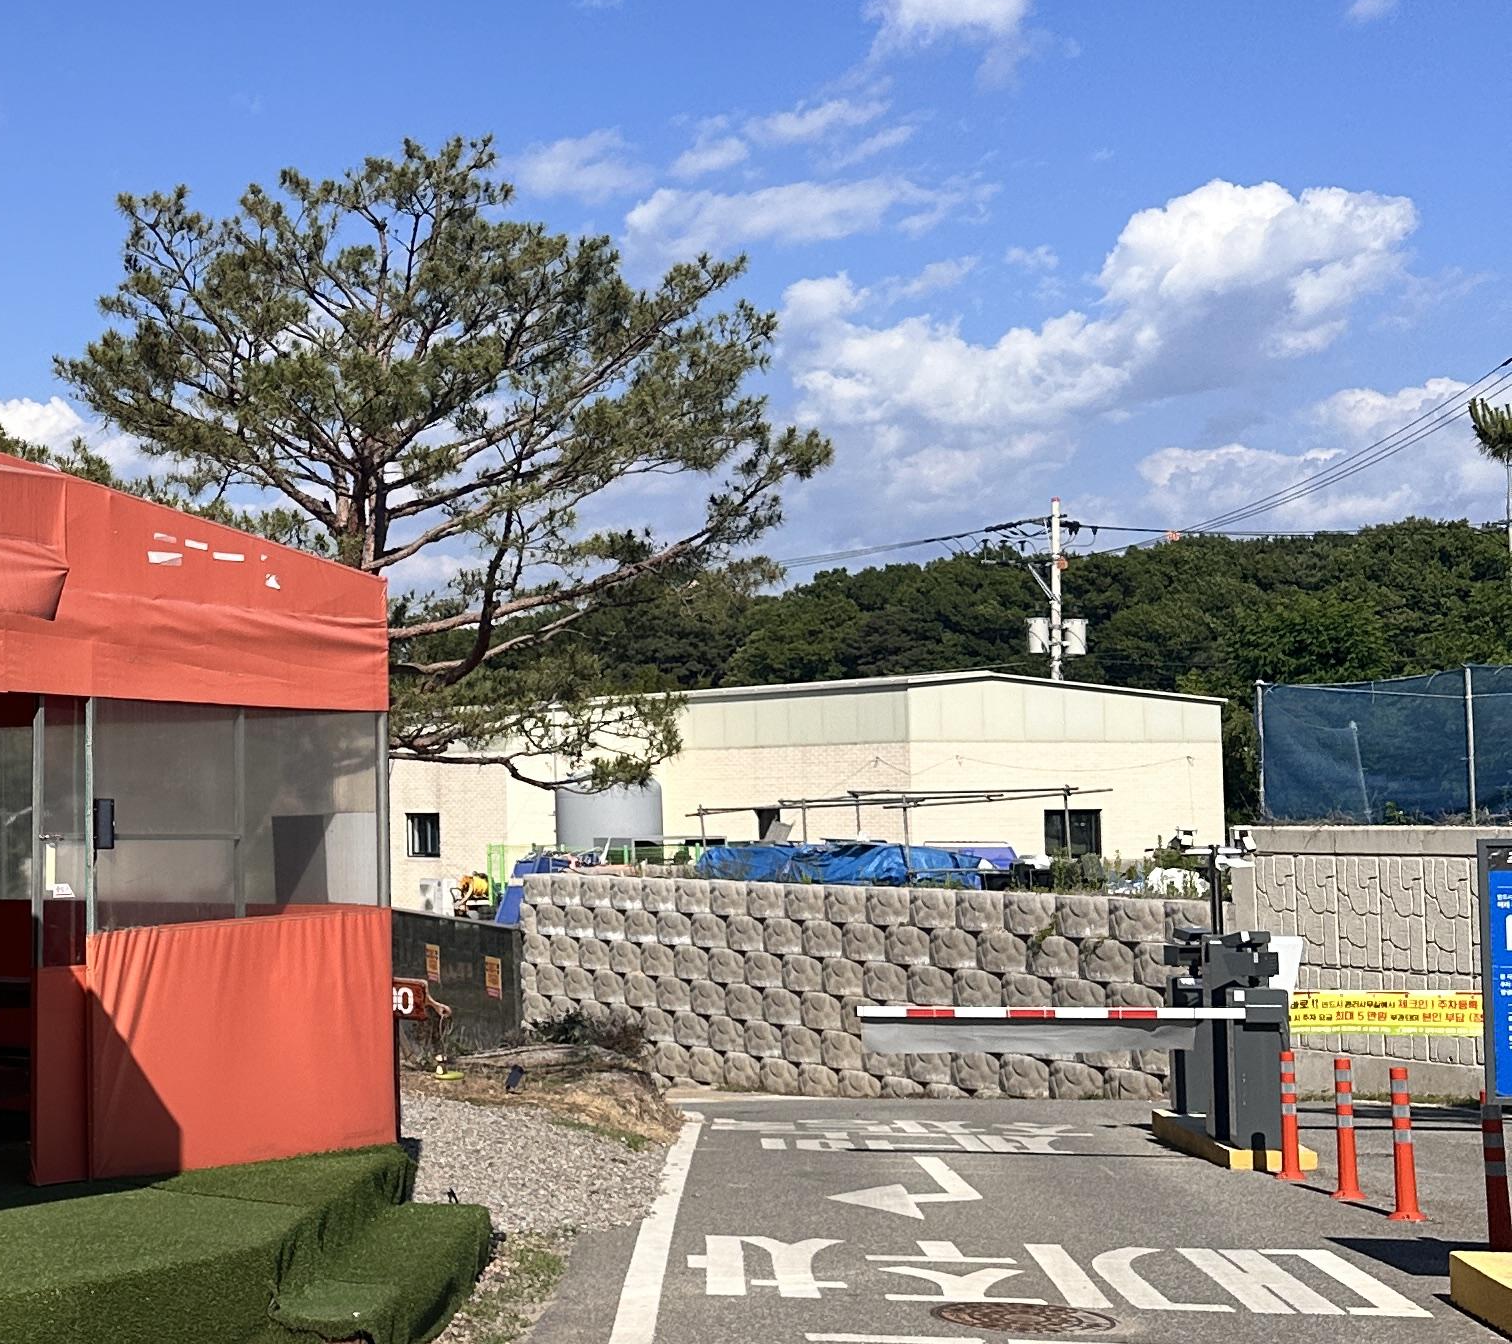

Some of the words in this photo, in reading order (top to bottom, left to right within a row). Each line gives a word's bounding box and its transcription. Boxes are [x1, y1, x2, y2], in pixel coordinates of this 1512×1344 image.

[1398, 999, 1428, 1009] 체크인
[1438, 999, 1478, 1010] 주차등록
[1335, 1011, 1354, 1021] 최대
[1422, 1013, 1442, 1022] 본인
